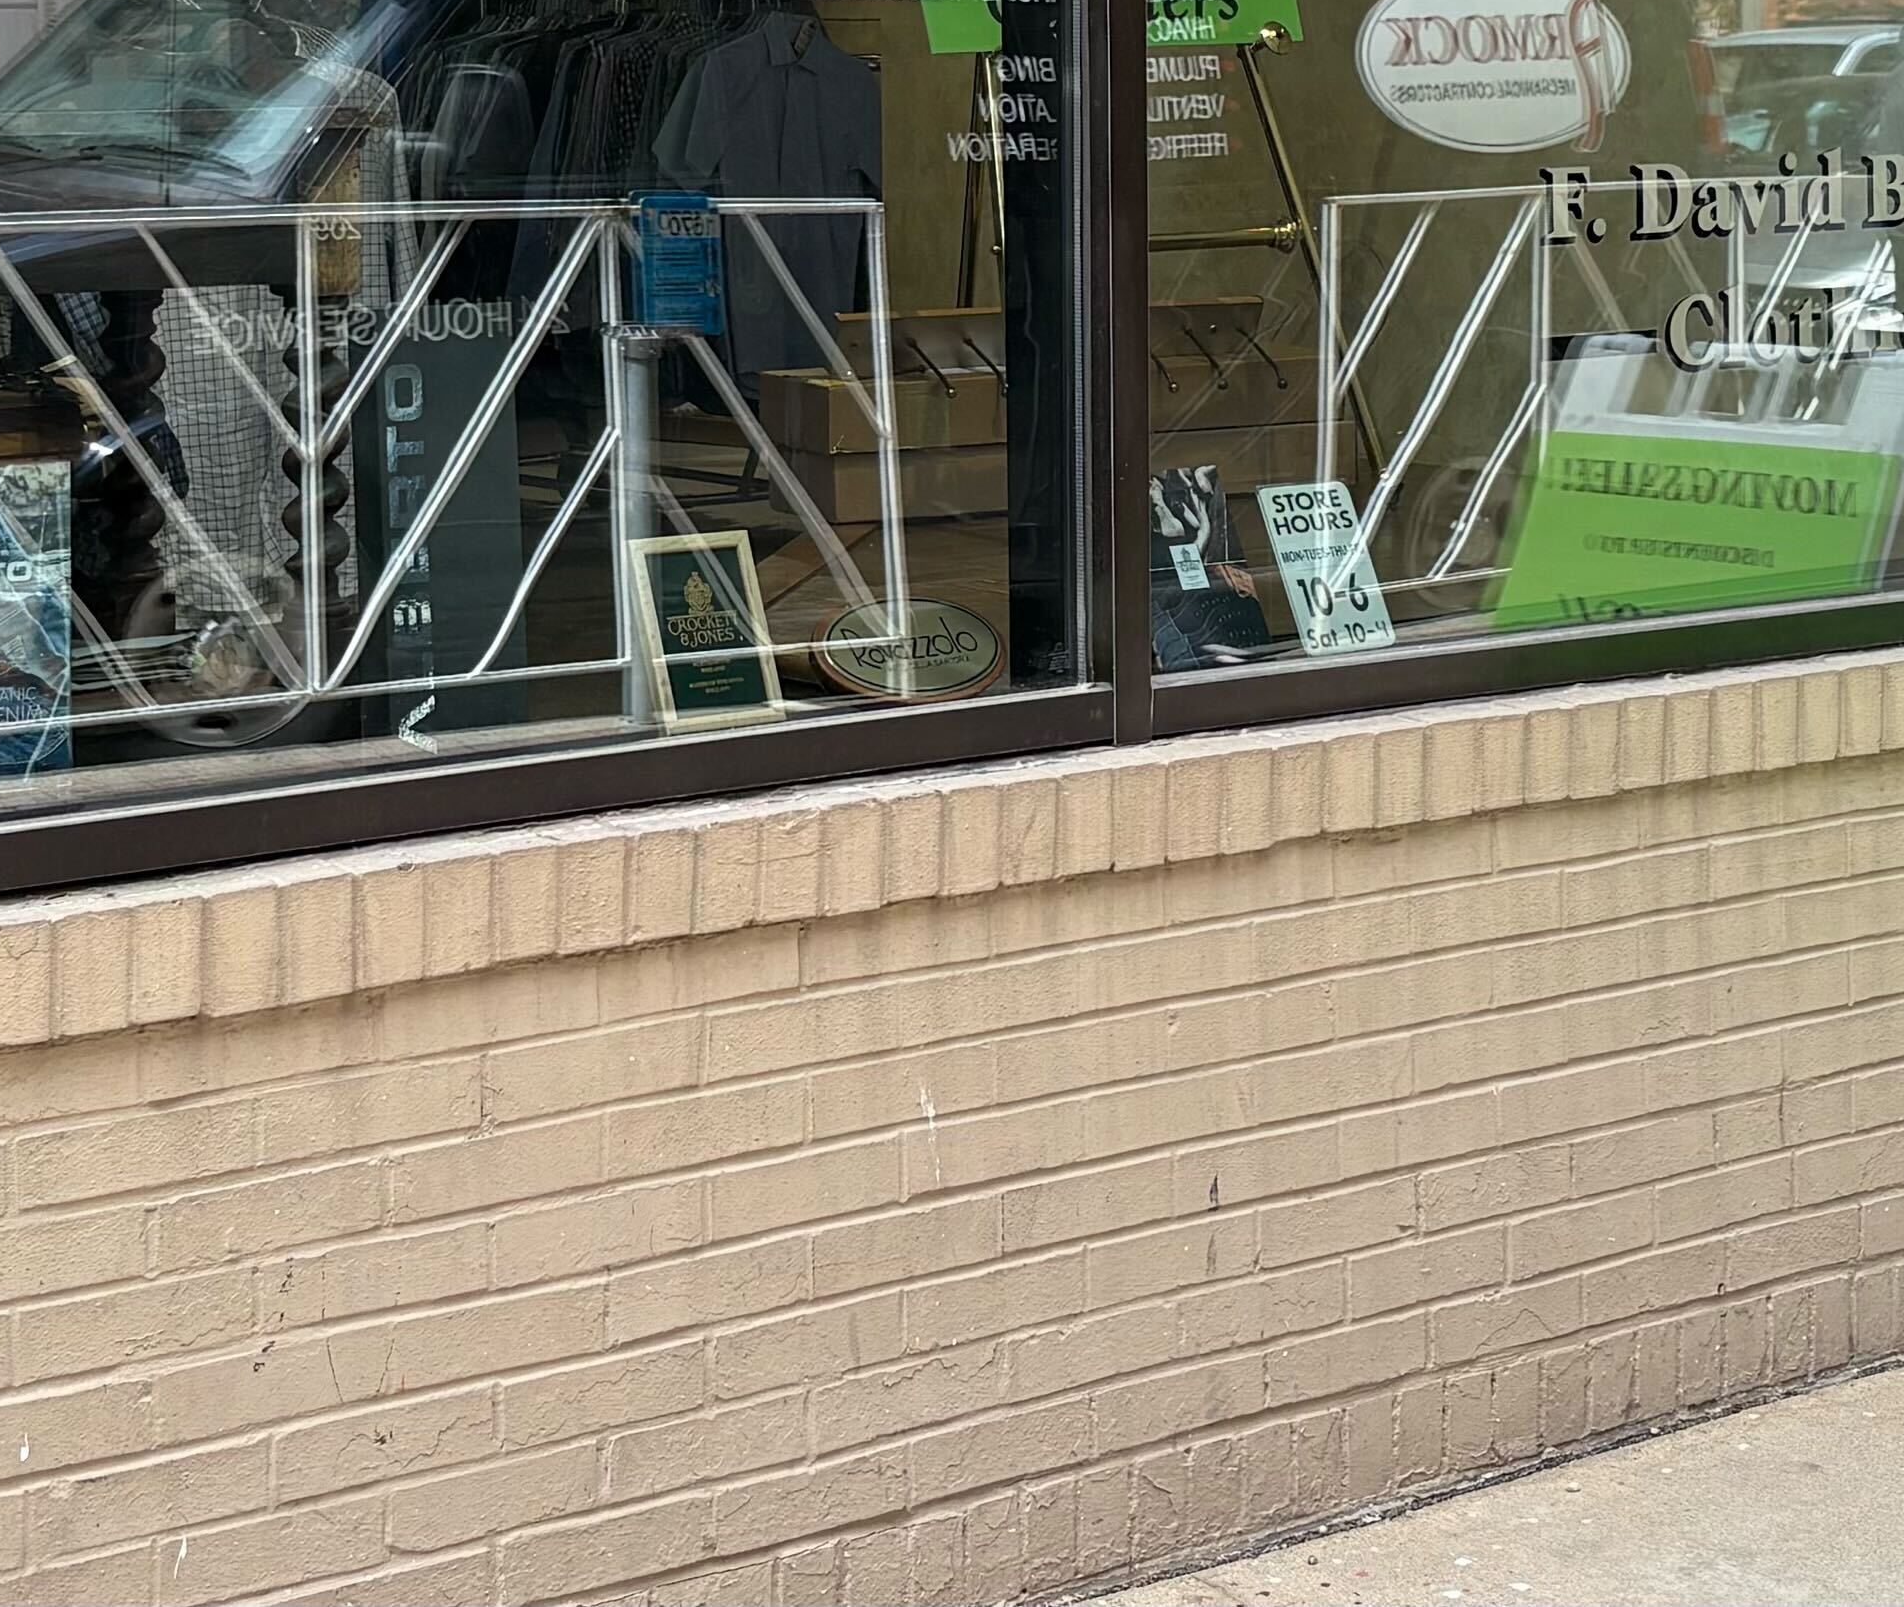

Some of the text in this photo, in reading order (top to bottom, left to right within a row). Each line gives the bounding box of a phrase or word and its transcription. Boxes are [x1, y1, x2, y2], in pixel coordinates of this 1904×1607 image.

[1540, 165, 1608, 246] F.
[1630, 147, 1847, 241] David
[1272, 488, 1343, 514] STORE
[1273, 510, 1355, 536] HOURS
[1297, 572, 1370, 618] 10-6
[690, 627, 736, 648] JONES
